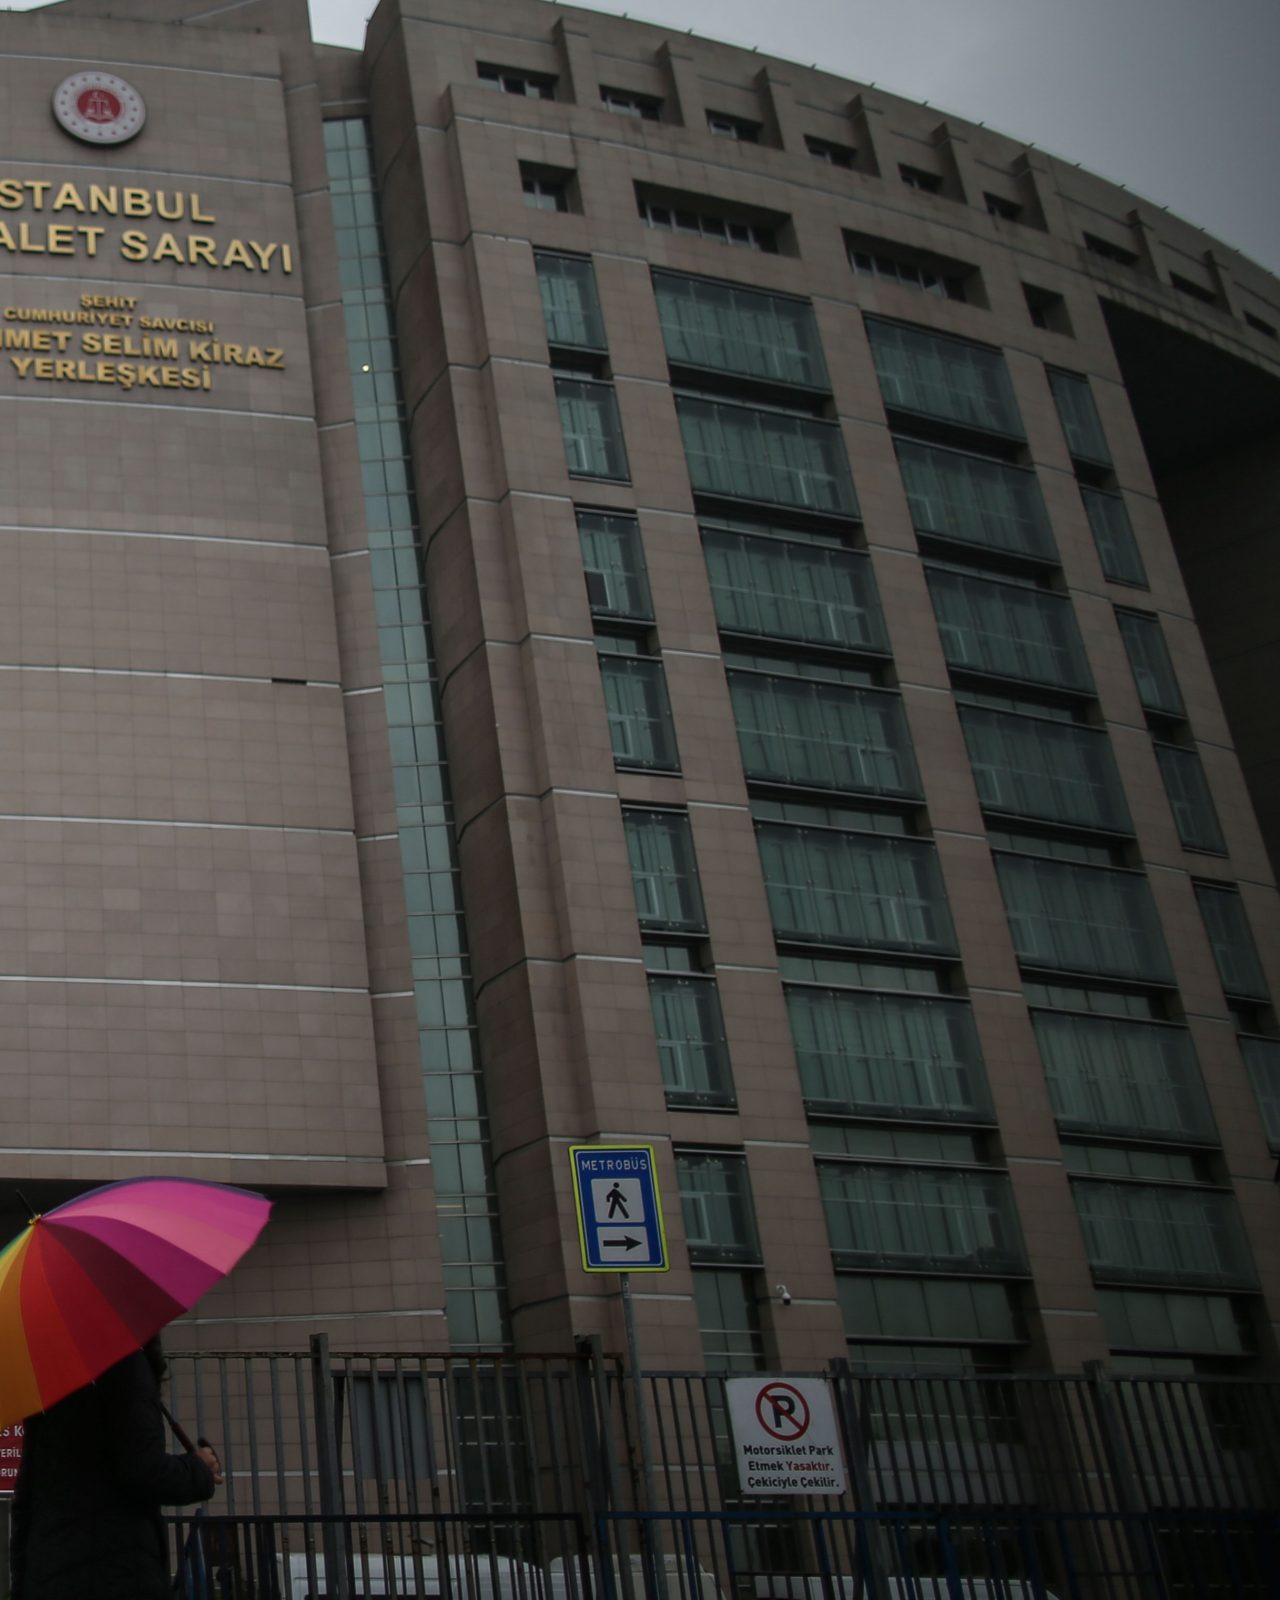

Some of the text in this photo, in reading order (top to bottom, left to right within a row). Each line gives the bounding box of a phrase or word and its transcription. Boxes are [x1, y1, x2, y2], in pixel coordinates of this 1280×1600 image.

[121, 230, 292, 274] SARAYI
[139, 315, 214, 334] SAVCISI
[82, 332, 179, 359] SELİM
[189, 338, 285, 369] KİRAZ
[11, 357, 212, 391] YERLEŞKESİ
[581, 1157, 647, 1171] METROBÜS
[743, 1445, 833, 1456] Motorsiklet Park
[748, 1461, 834, 1471] Etmek Yasaktır.
[747, 1477, 839, 1489] Çekiciyle Çekilir.
